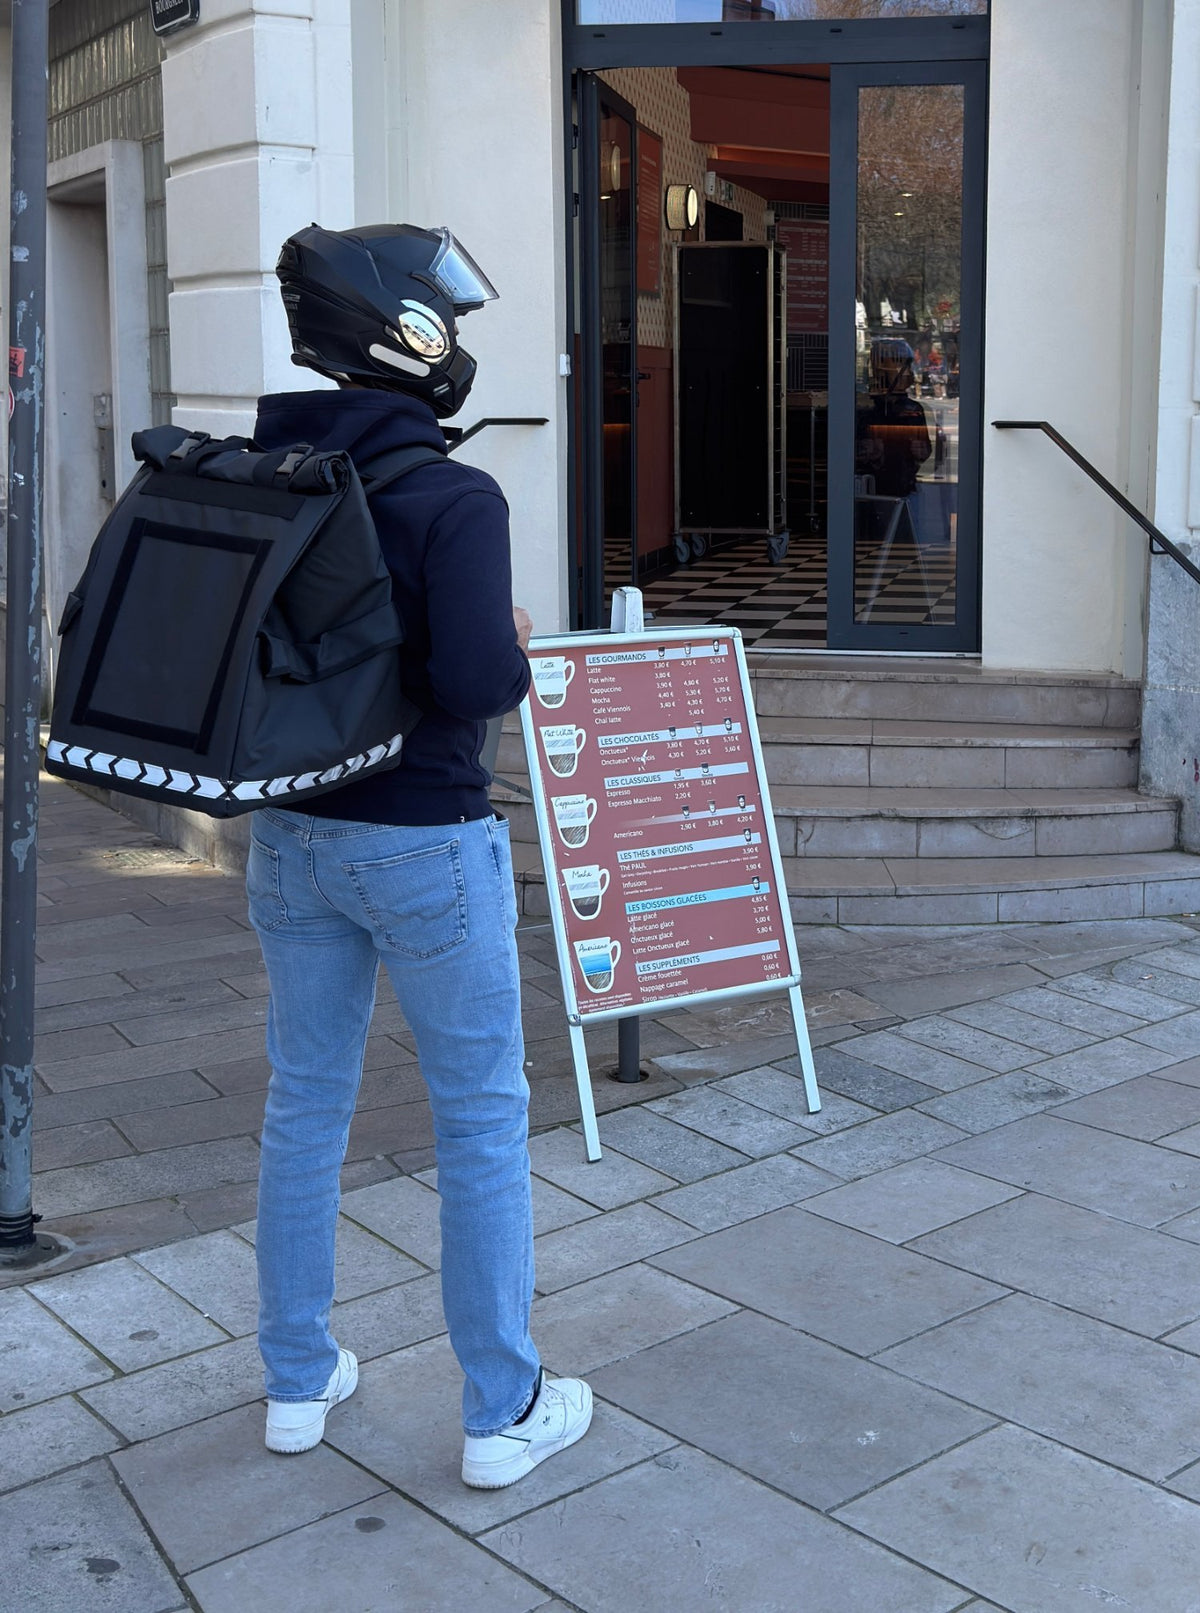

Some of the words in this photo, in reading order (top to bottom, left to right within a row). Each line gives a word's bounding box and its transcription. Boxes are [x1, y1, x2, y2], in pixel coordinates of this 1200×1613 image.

[602, 653, 647, 663] GOURMANDS
[606, 705, 631, 713] Viennois
[614, 733, 659, 744] CHOCOLATÉS
[621, 775, 661, 785] CLASSIQUES
[614, 830, 643, 838] Americano
[633, 849, 649, 857] THÉS
[657, 844, 693, 855] INFUSIONS
[628, 904, 640, 912] LES
[642, 900, 675, 910] BOISSONS
[677, 894, 706, 904] GLACÉES
[643, 912, 657, 921] glacé
[629, 924, 659, 933] Americano
[660, 920, 674, 929] glacé
[631, 935, 657, 943] Onctueux
[659, 931, 673, 940] glacé
[647, 943, 674, 952] Onctueux
[675, 939, 690, 948] glacé
[639, 964, 650, 972] LES
[652, 955, 700, 970] SUPPLÉMENTS
[658, 970, 682, 979] fouettée
[640, 983, 665, 992] Nappage
[666, 978, 688, 988] caramel
